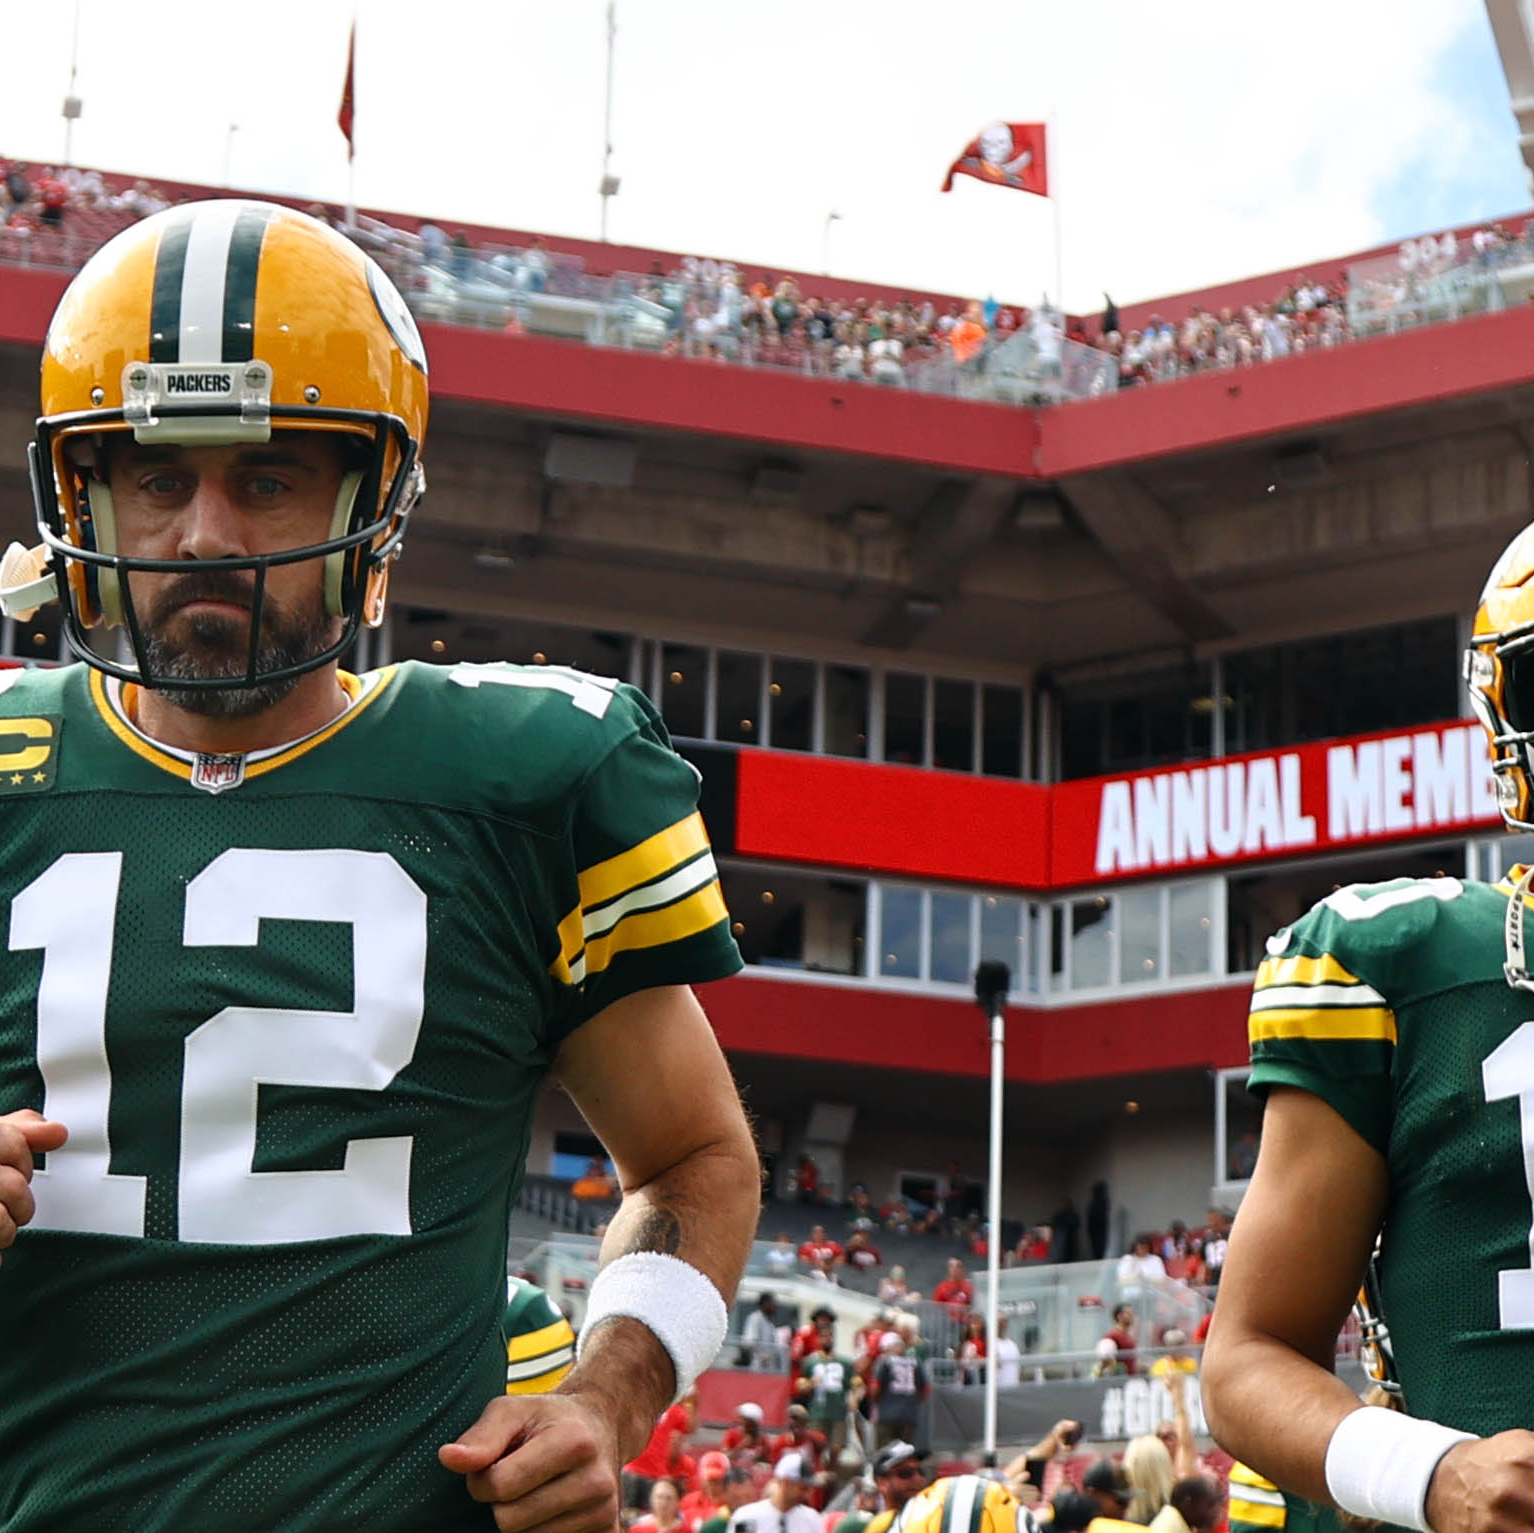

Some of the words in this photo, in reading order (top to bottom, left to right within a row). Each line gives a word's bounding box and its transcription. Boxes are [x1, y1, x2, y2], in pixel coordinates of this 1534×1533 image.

[167, 373, 231, 393] PACKERS
[200, 764, 236, 783] NFL
[1095, 751, 1317, 873] ANNUAL
[8, 848, 428, 1244] 12
